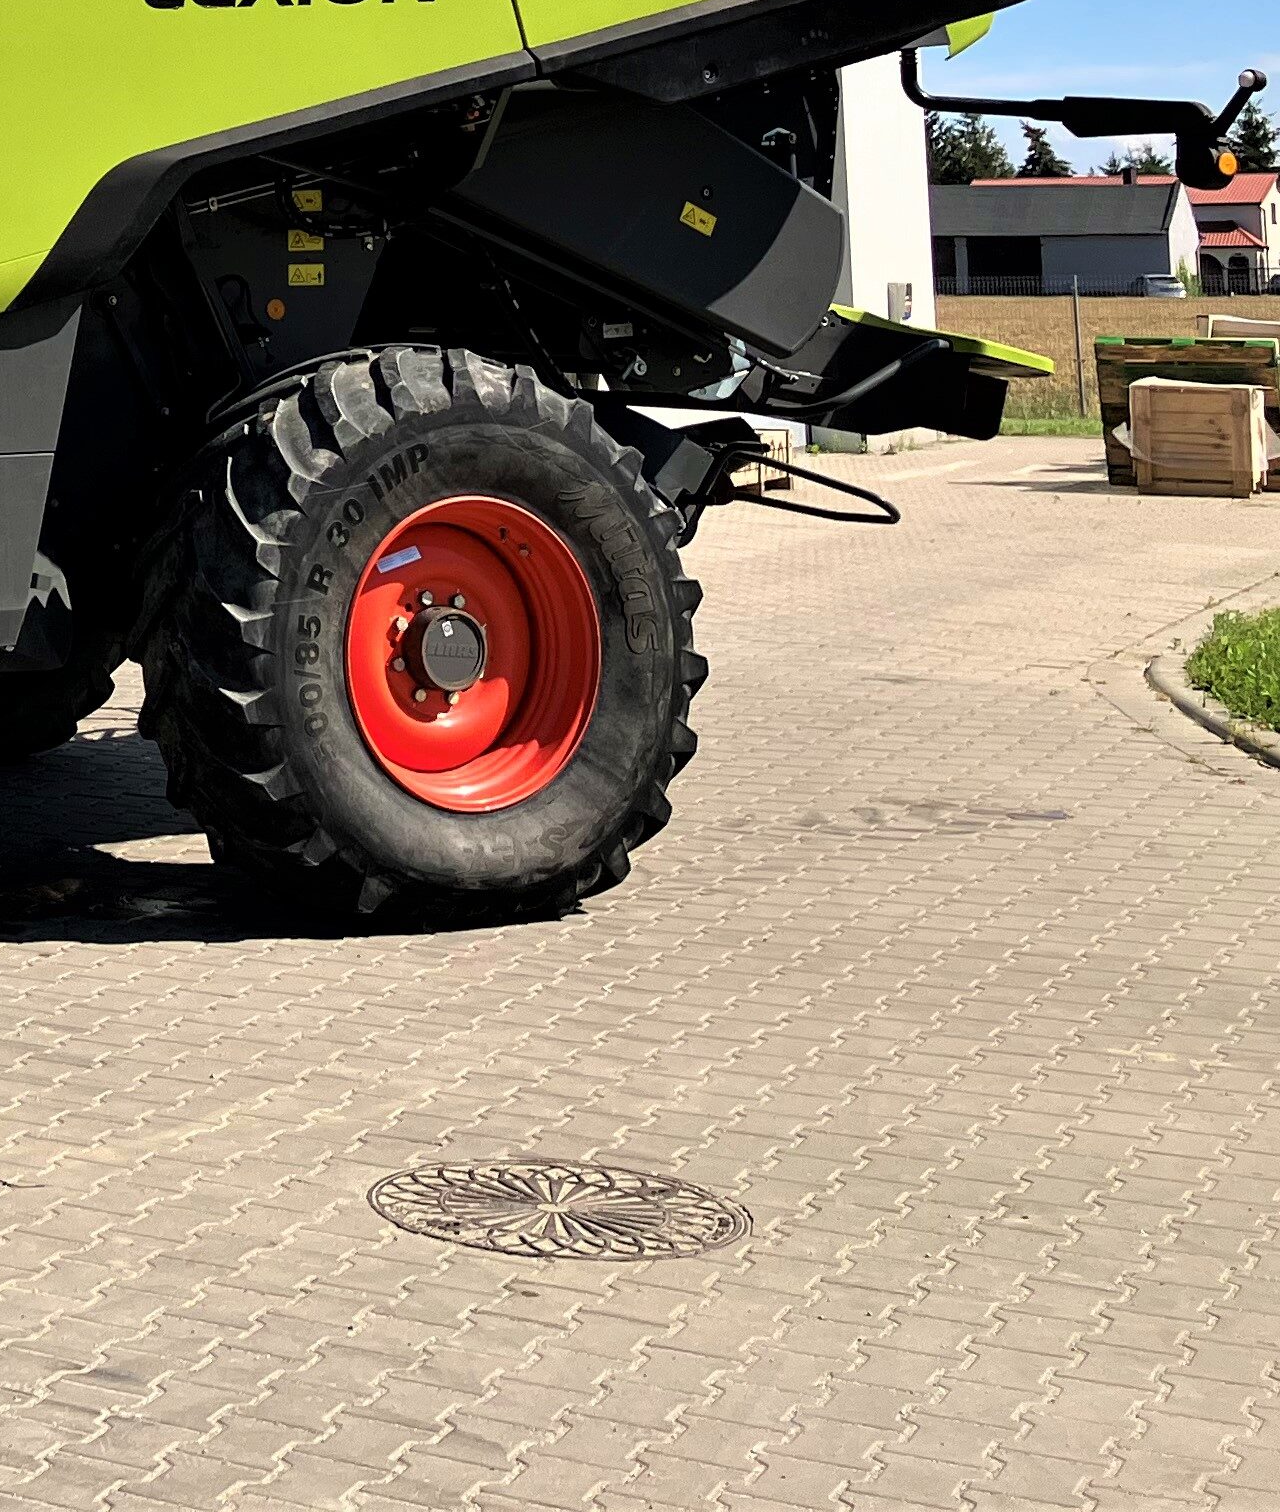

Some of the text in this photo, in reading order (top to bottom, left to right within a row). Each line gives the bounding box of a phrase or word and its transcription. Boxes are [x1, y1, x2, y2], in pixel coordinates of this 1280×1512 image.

[305, 563, 334, 595] R
[326, 498, 365, 548] 30
[366, 442, 430, 503] IMP
